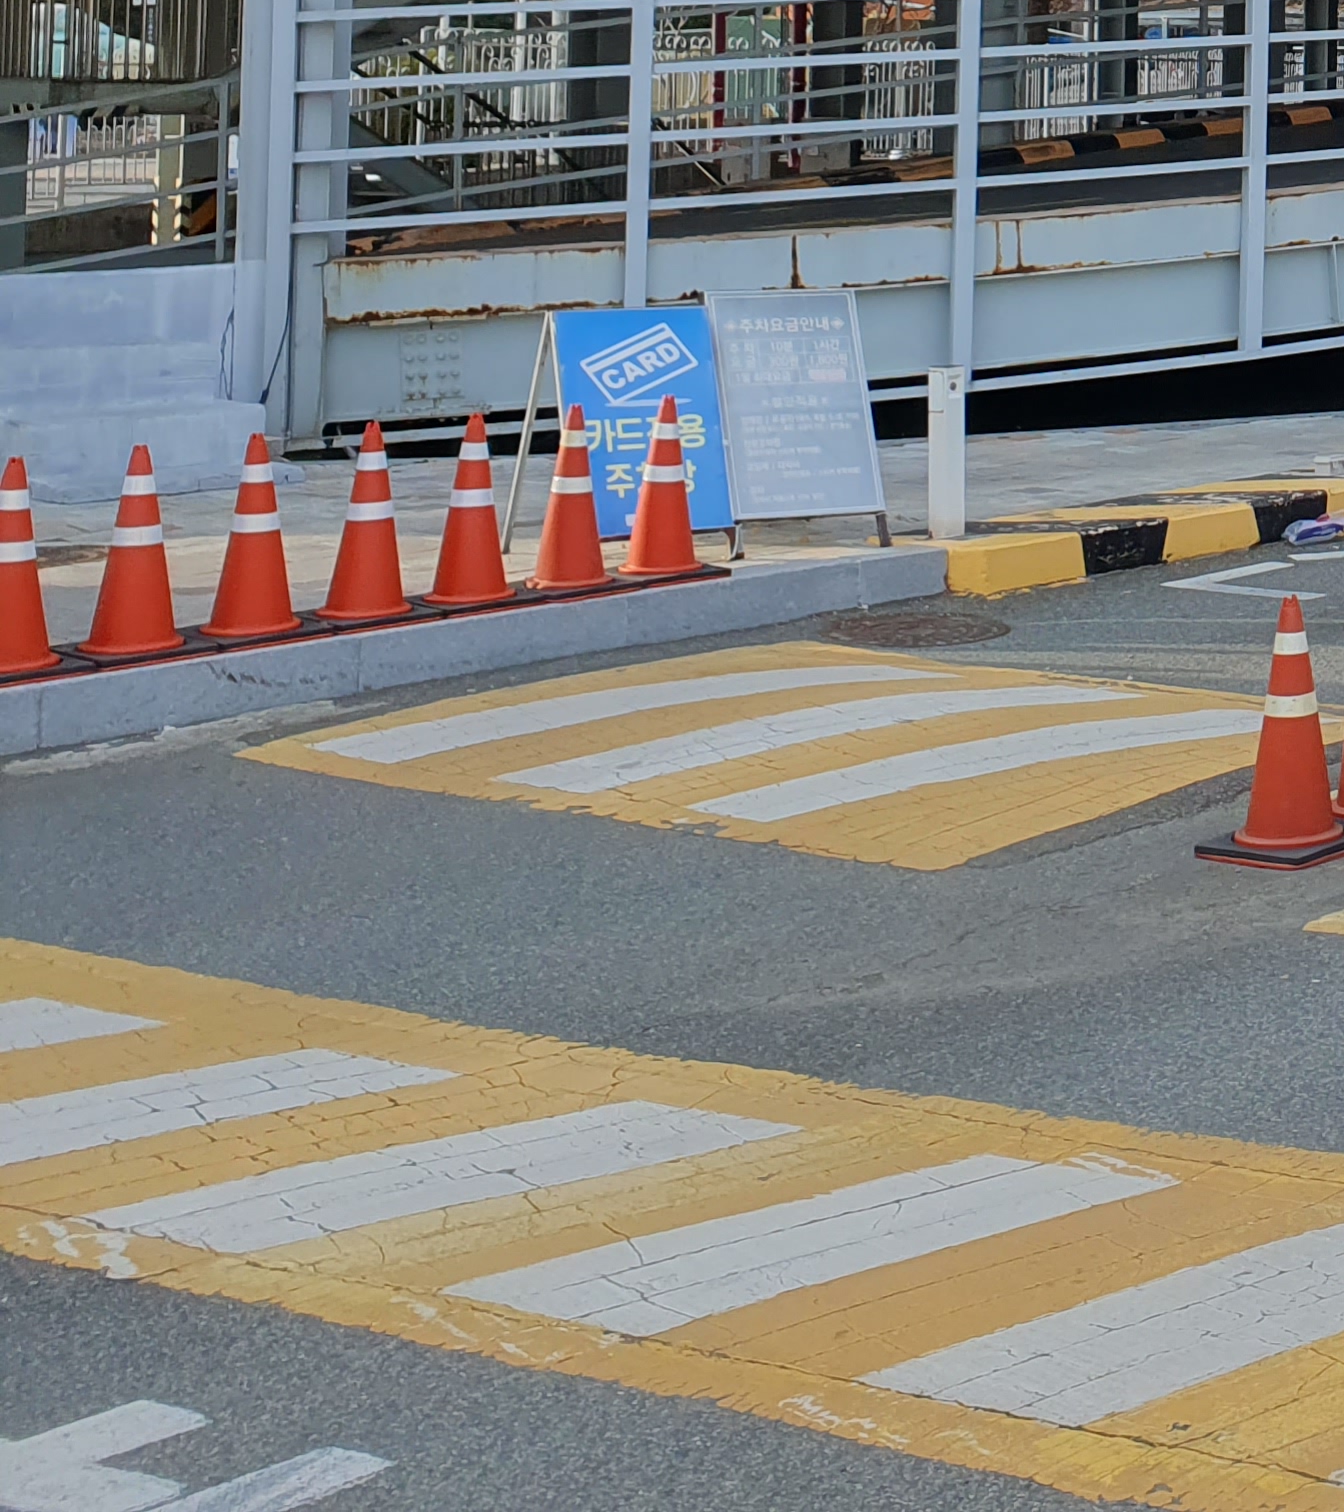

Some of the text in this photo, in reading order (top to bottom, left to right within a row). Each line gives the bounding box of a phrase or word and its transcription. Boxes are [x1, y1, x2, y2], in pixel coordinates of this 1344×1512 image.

[738, 316, 831, 334] 주차요금안내
[770, 340, 794, 353] 10분
[813, 339, 840, 351] 1시간
[601, 341, 682, 390] CARD
